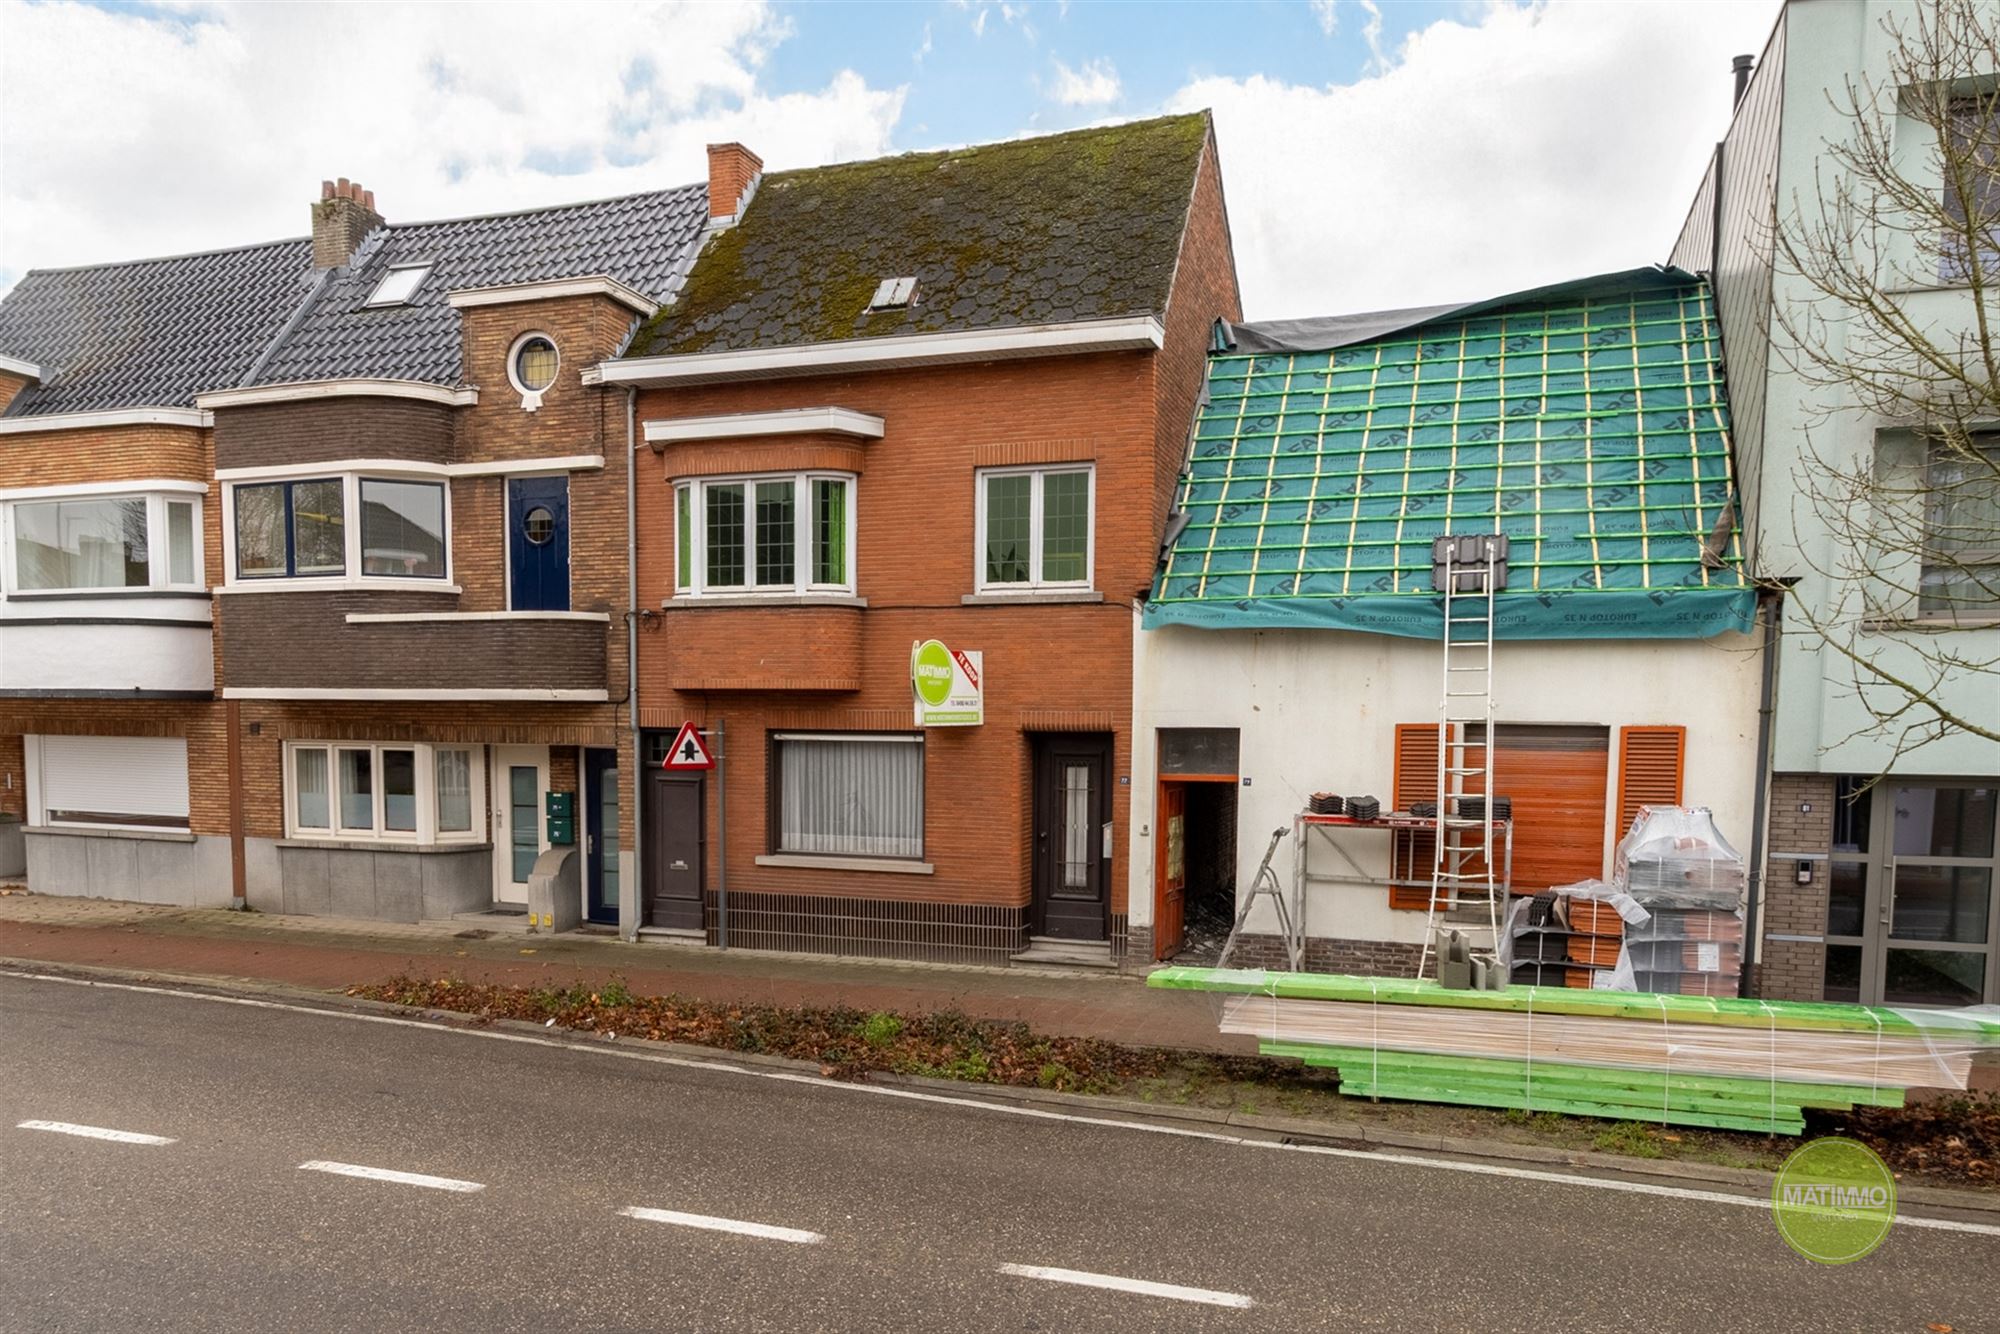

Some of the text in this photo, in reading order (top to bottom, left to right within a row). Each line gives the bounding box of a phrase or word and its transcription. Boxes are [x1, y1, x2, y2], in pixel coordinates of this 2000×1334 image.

[1354, 614, 1366, 623] 35
[1379, 615, 1423, 623] EUROTOP
[1564, 613, 1638, 622] EUROTOP N 35
